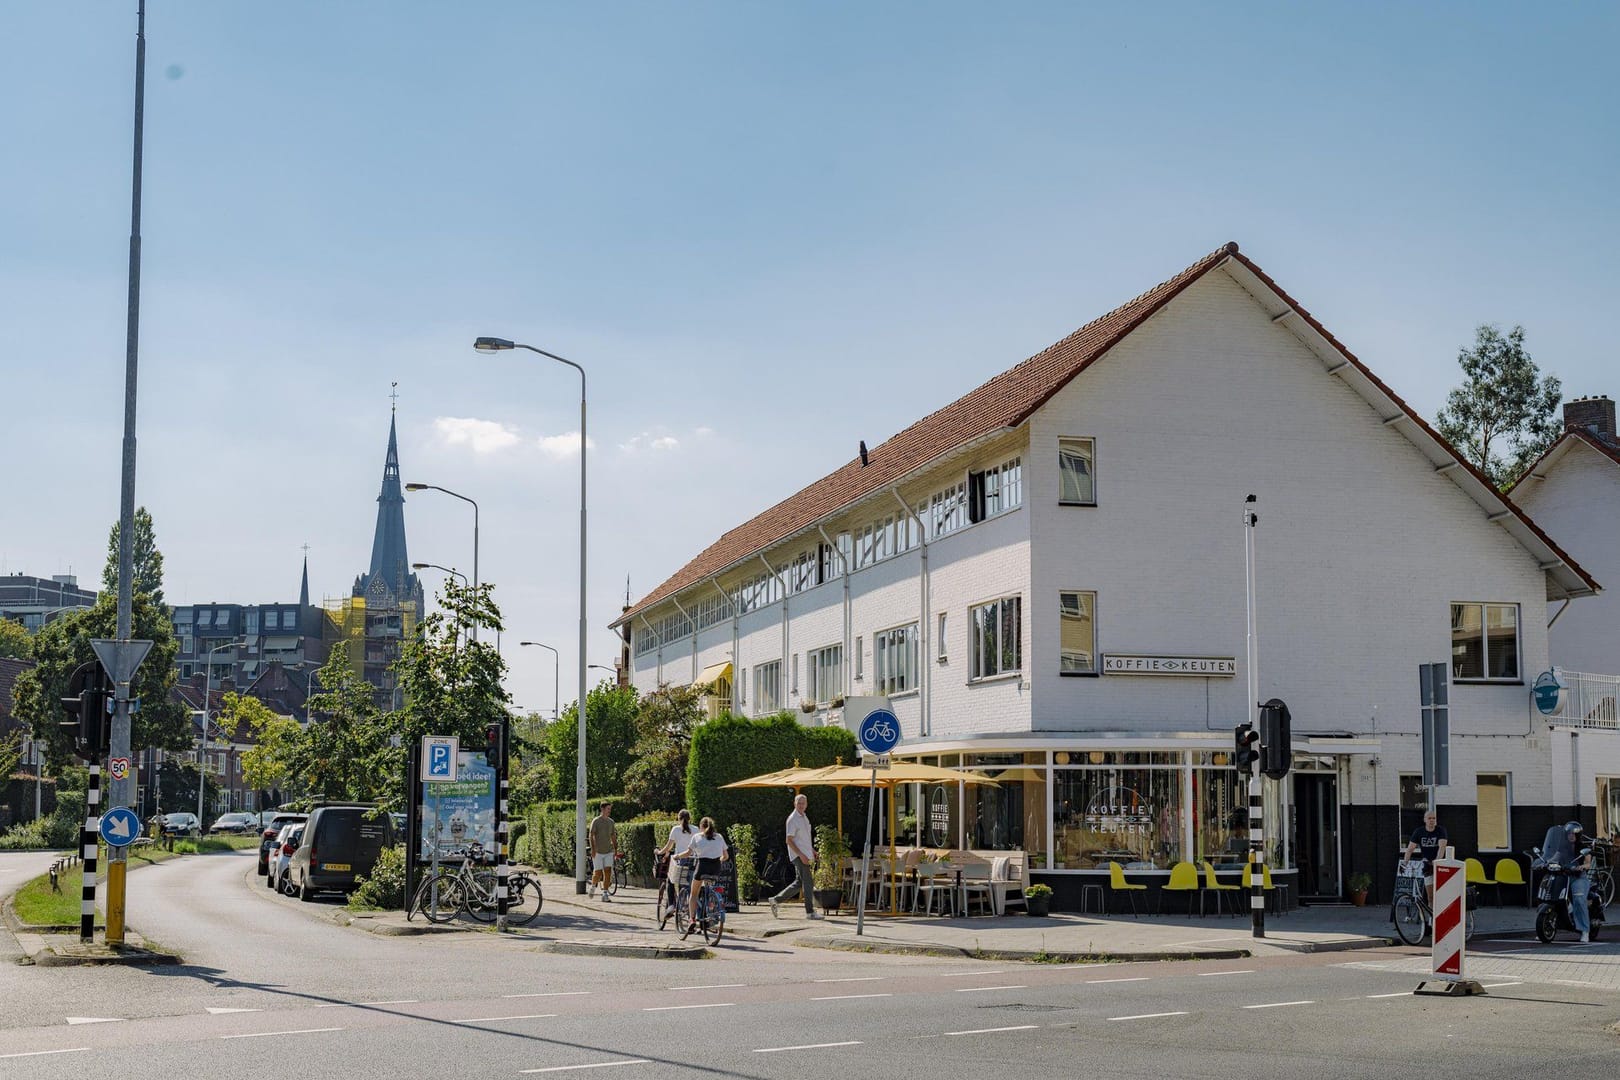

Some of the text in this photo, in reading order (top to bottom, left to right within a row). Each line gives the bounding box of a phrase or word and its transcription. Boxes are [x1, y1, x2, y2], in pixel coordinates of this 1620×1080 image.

[1106, 659, 1235, 671] KOFFIE KEUTEN
[434, 747, 446, 763] P
[113, 763, 126, 773] 50
[1090, 805, 1145, 815] KOFFIE
[1091, 824, 1145, 834] KEUTEN
